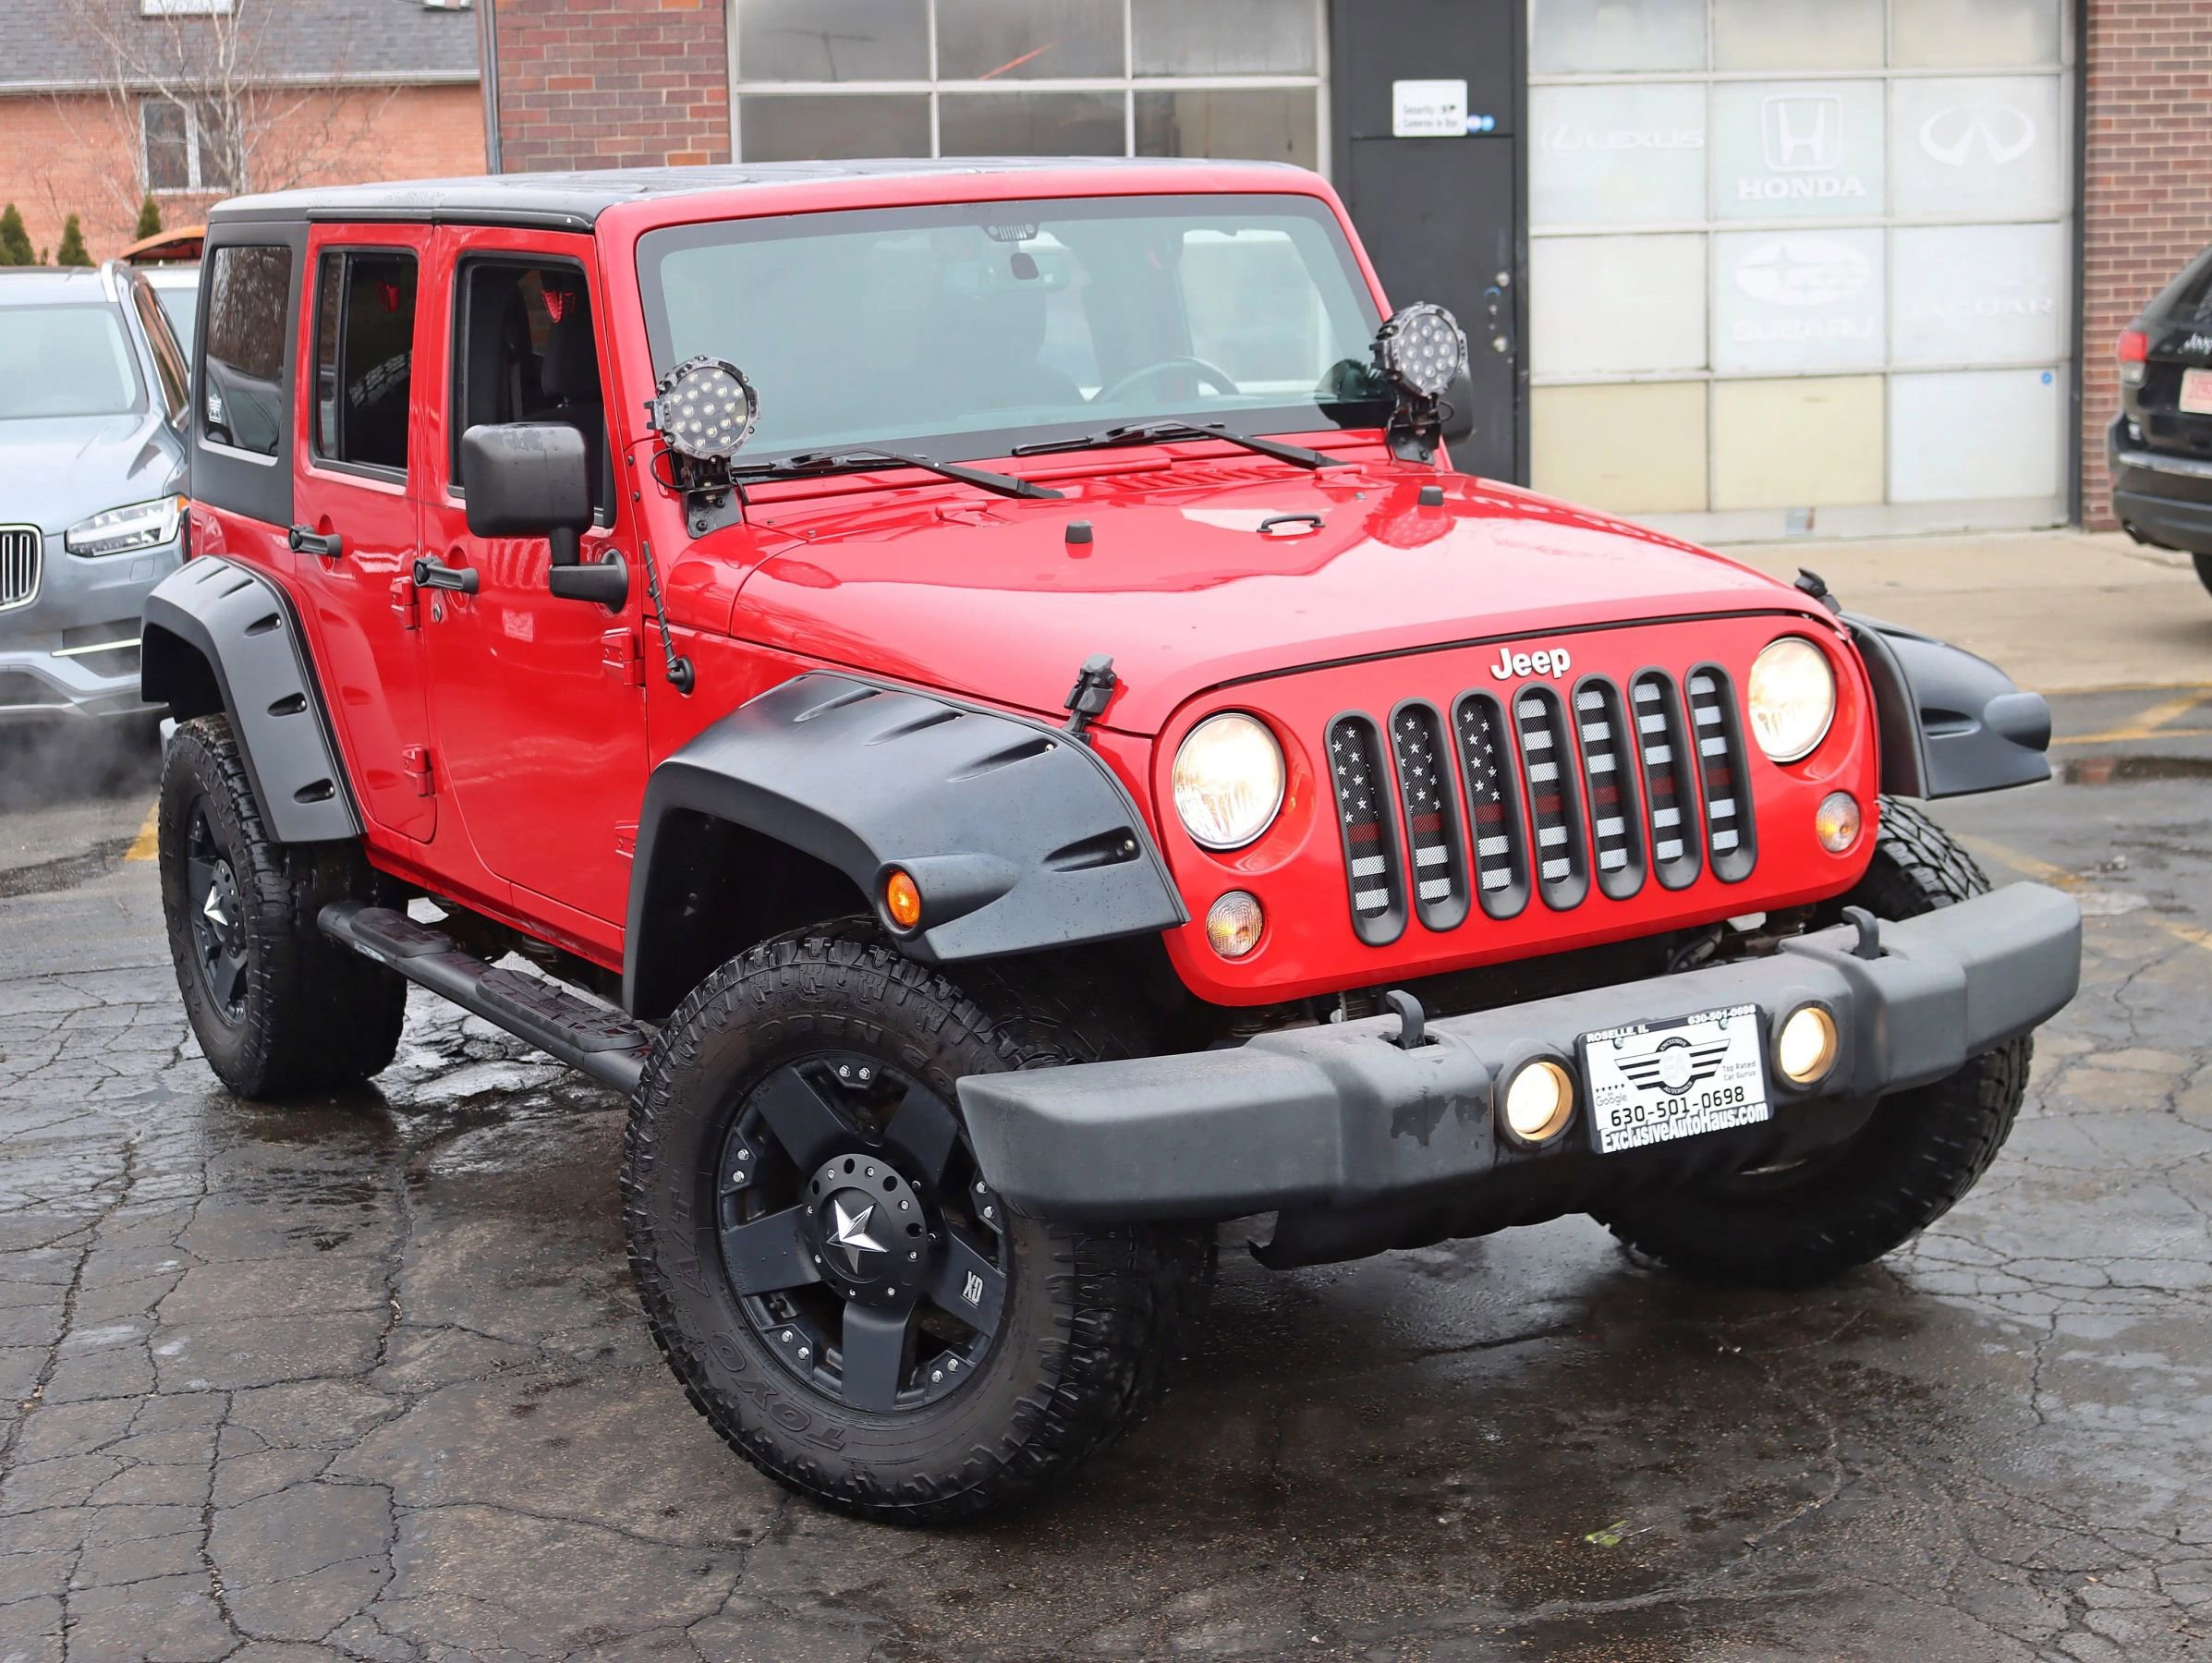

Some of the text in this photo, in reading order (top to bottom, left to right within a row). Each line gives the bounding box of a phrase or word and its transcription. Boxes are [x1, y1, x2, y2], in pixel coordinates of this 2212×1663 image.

[1586, 129, 1705, 149] LEXUS
[1737, 176, 1866, 200] HONDA
[1732, 317, 1873, 342] SUBARU
[1490, 648, 1571, 679] Jeep
[1687, 1004, 1756, 1025] 630-501-0698
[1637, 1025, 1649, 1035] IL
[1596, 1093, 1627, 1107] Google
[1610, 1086, 1744, 1127] 630-501-0698
[1600, 1102, 1769, 1154] ExclusiveAutoHaus.com
[962, 1269, 984, 1304] XD
[708, 1331, 845, 1452] TOYO
